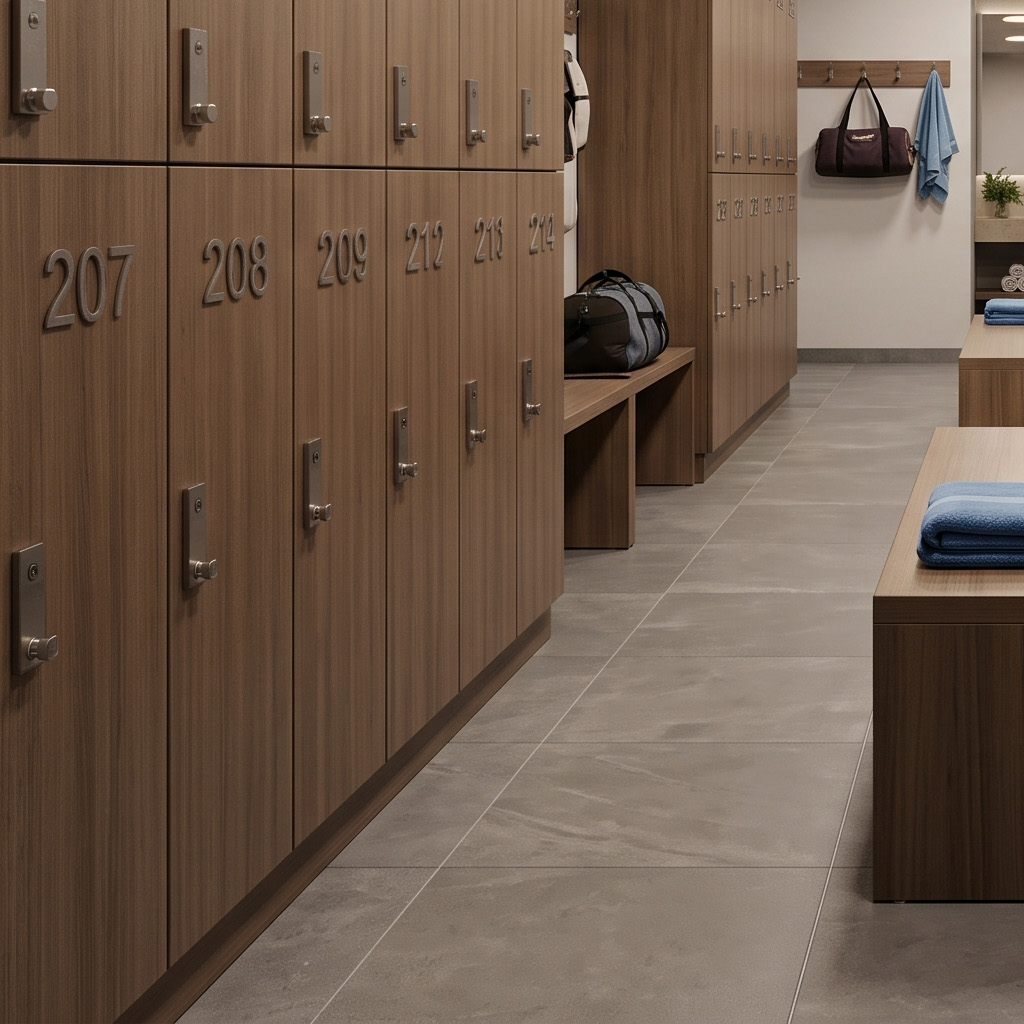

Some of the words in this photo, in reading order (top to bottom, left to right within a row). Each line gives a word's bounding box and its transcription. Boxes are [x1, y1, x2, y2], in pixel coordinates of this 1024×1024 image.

[318, 228, 368, 287] 209
[405, 221, 444, 273] 212
[529, 213, 555, 255] 214
[43, 244, 135, 330] 207
[202, 235, 269, 304] 208
